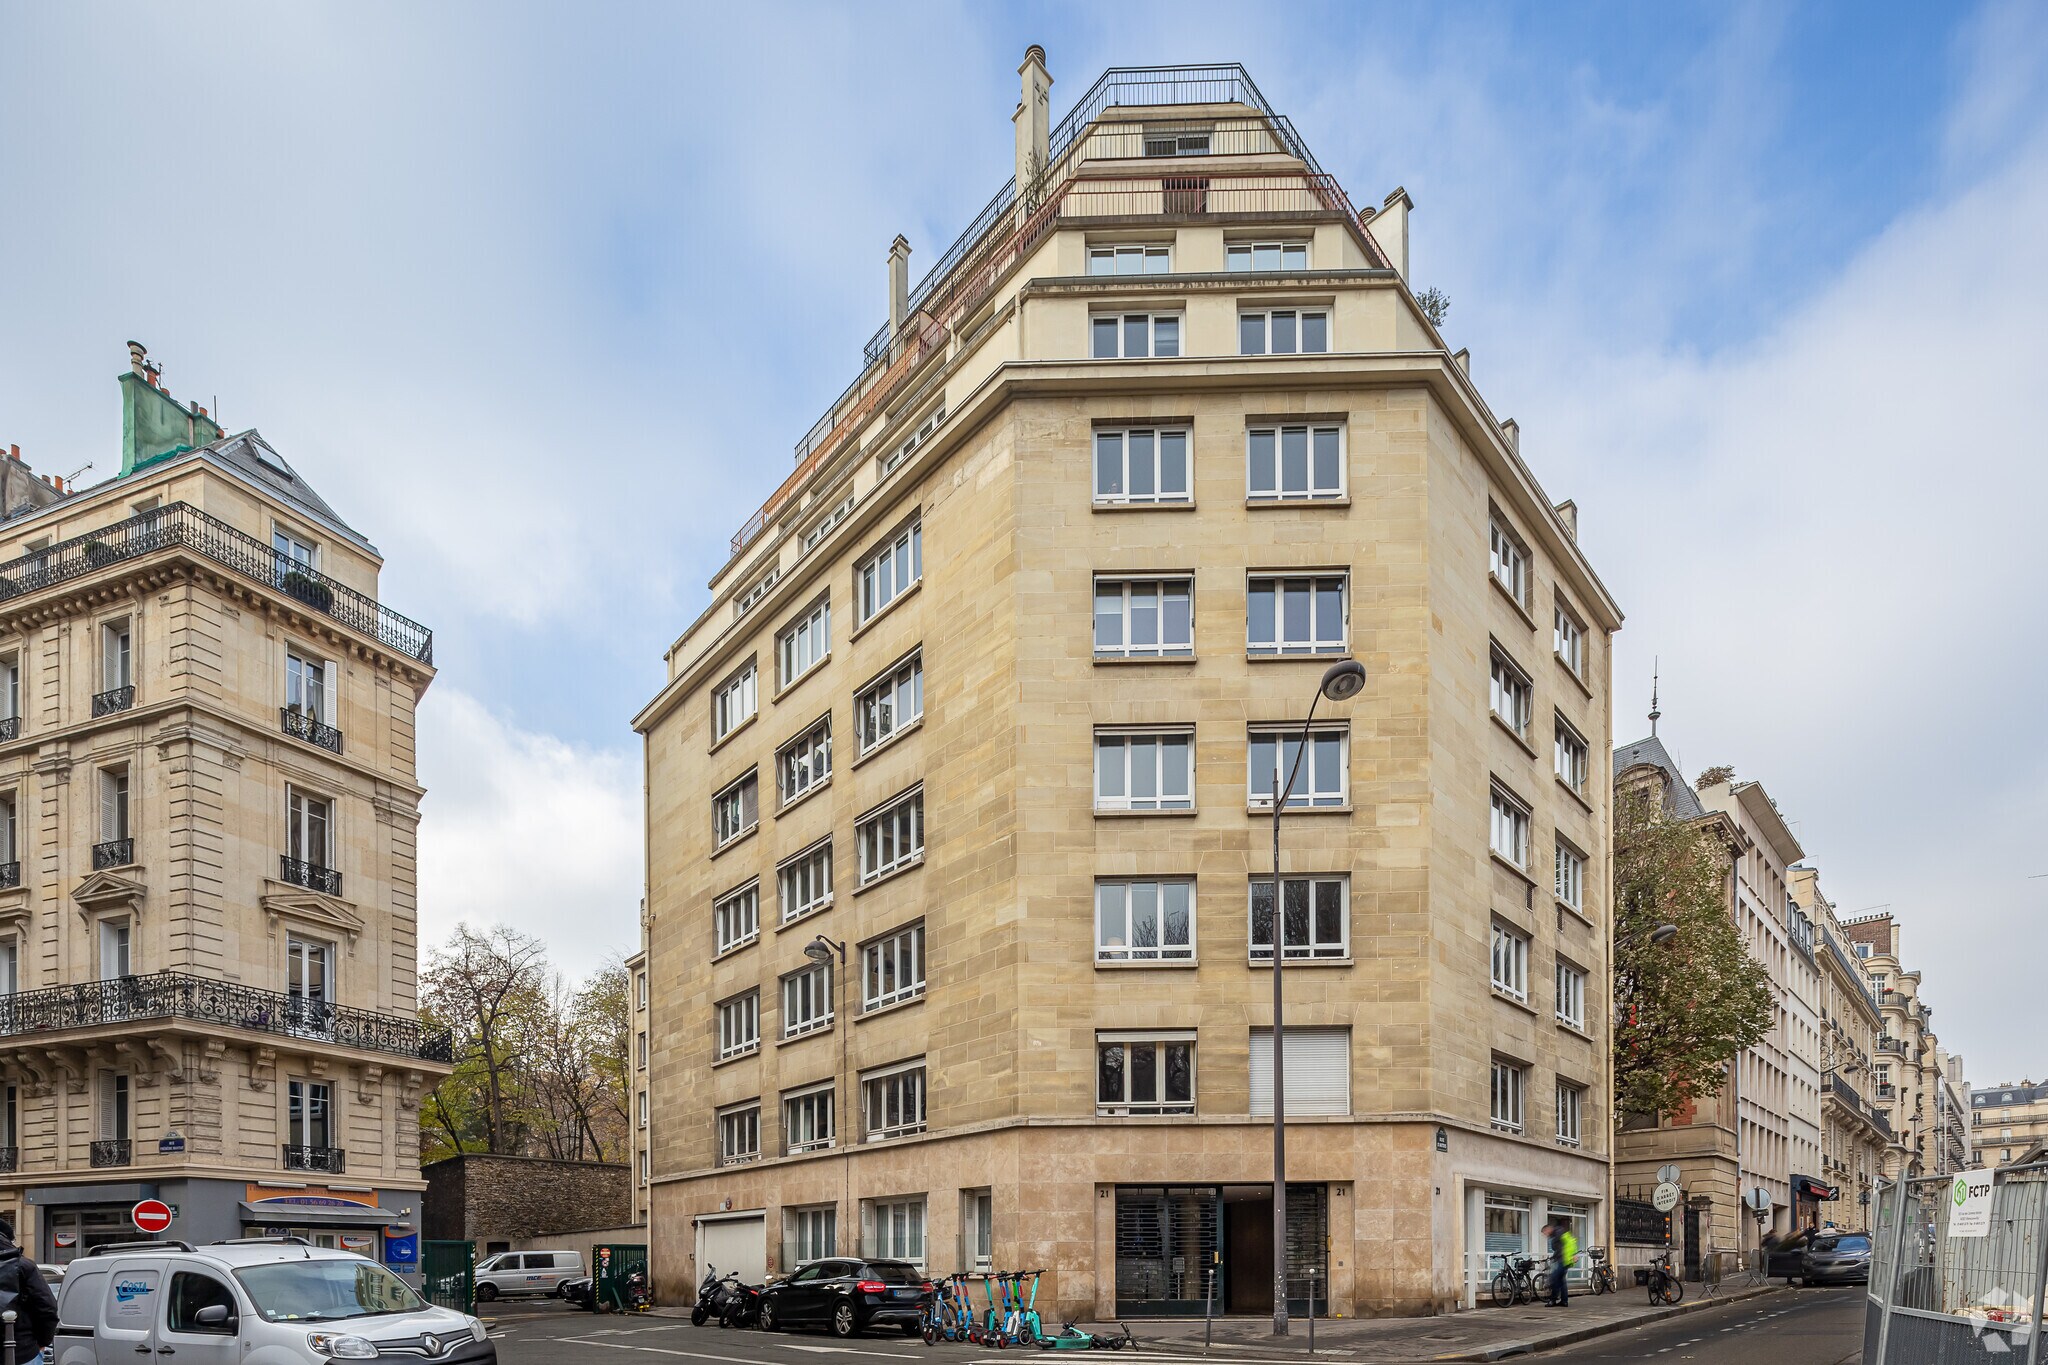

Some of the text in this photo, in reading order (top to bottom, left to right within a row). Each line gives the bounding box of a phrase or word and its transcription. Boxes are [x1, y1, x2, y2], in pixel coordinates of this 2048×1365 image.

[1100, 1190, 1108, 1198] 21
[1968, 1184, 1990, 1198] FCTP
[1656, 1198, 1676, 1206] INTERDIT
